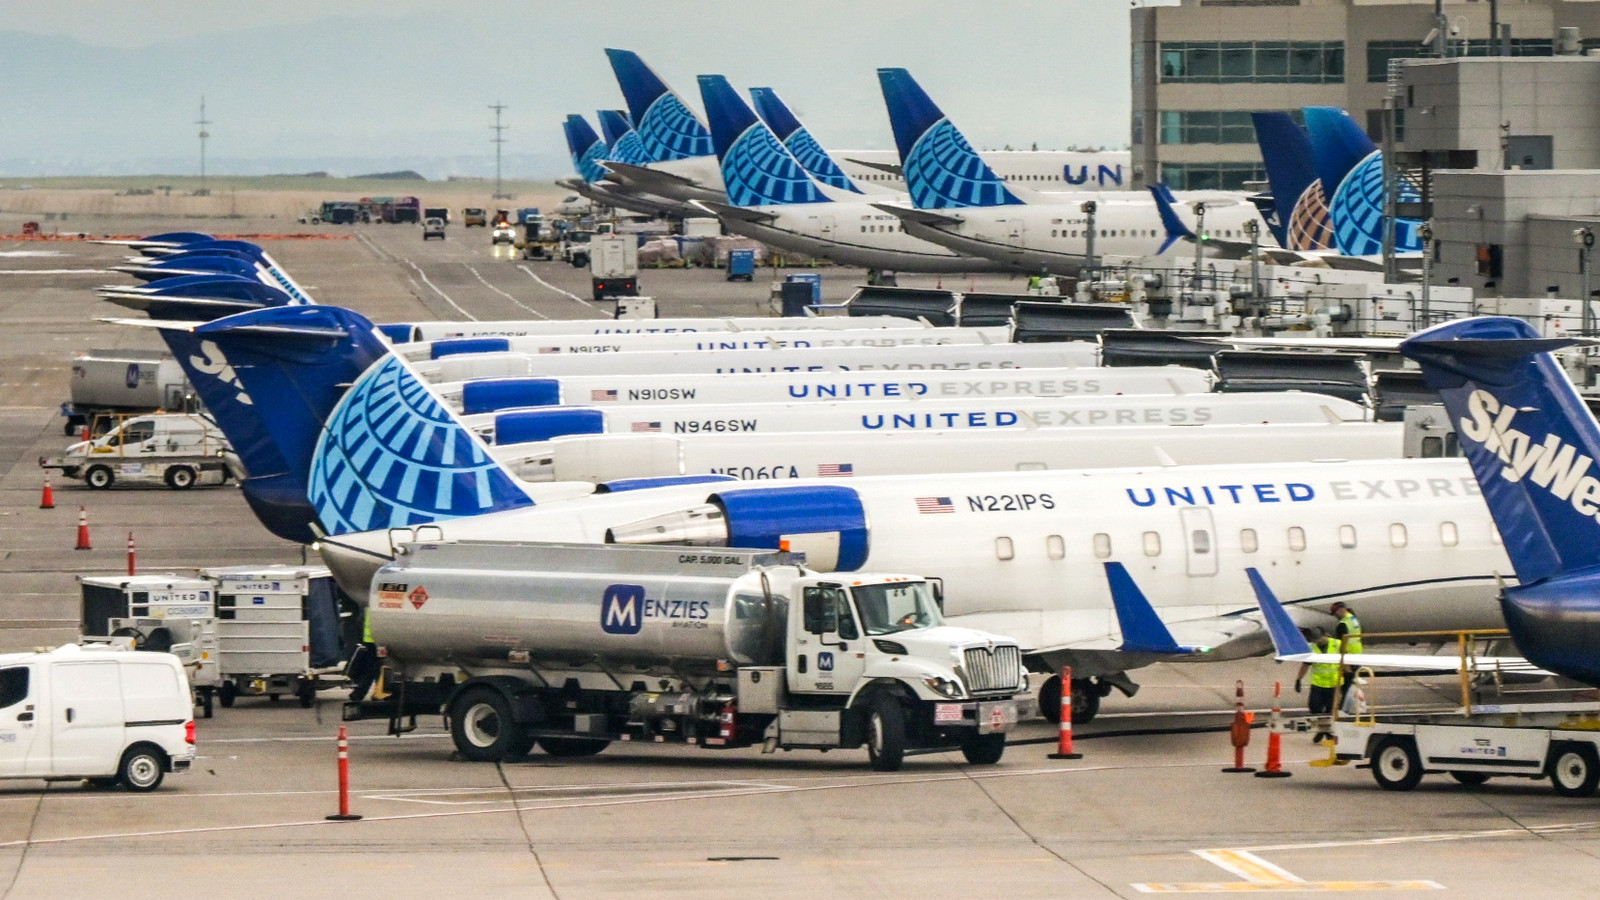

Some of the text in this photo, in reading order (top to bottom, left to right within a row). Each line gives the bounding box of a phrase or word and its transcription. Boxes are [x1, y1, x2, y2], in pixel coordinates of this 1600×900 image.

[628, 388, 696, 401] N910SW
[788, 379, 1100, 398] UNITED EXPRESS
[674, 419, 757, 433] N946SW
[861, 407, 1213, 429] UNITED EXPRESS
[1126, 482, 1316, 507] UNITED
[153, 593, 197, 602] UNITED
